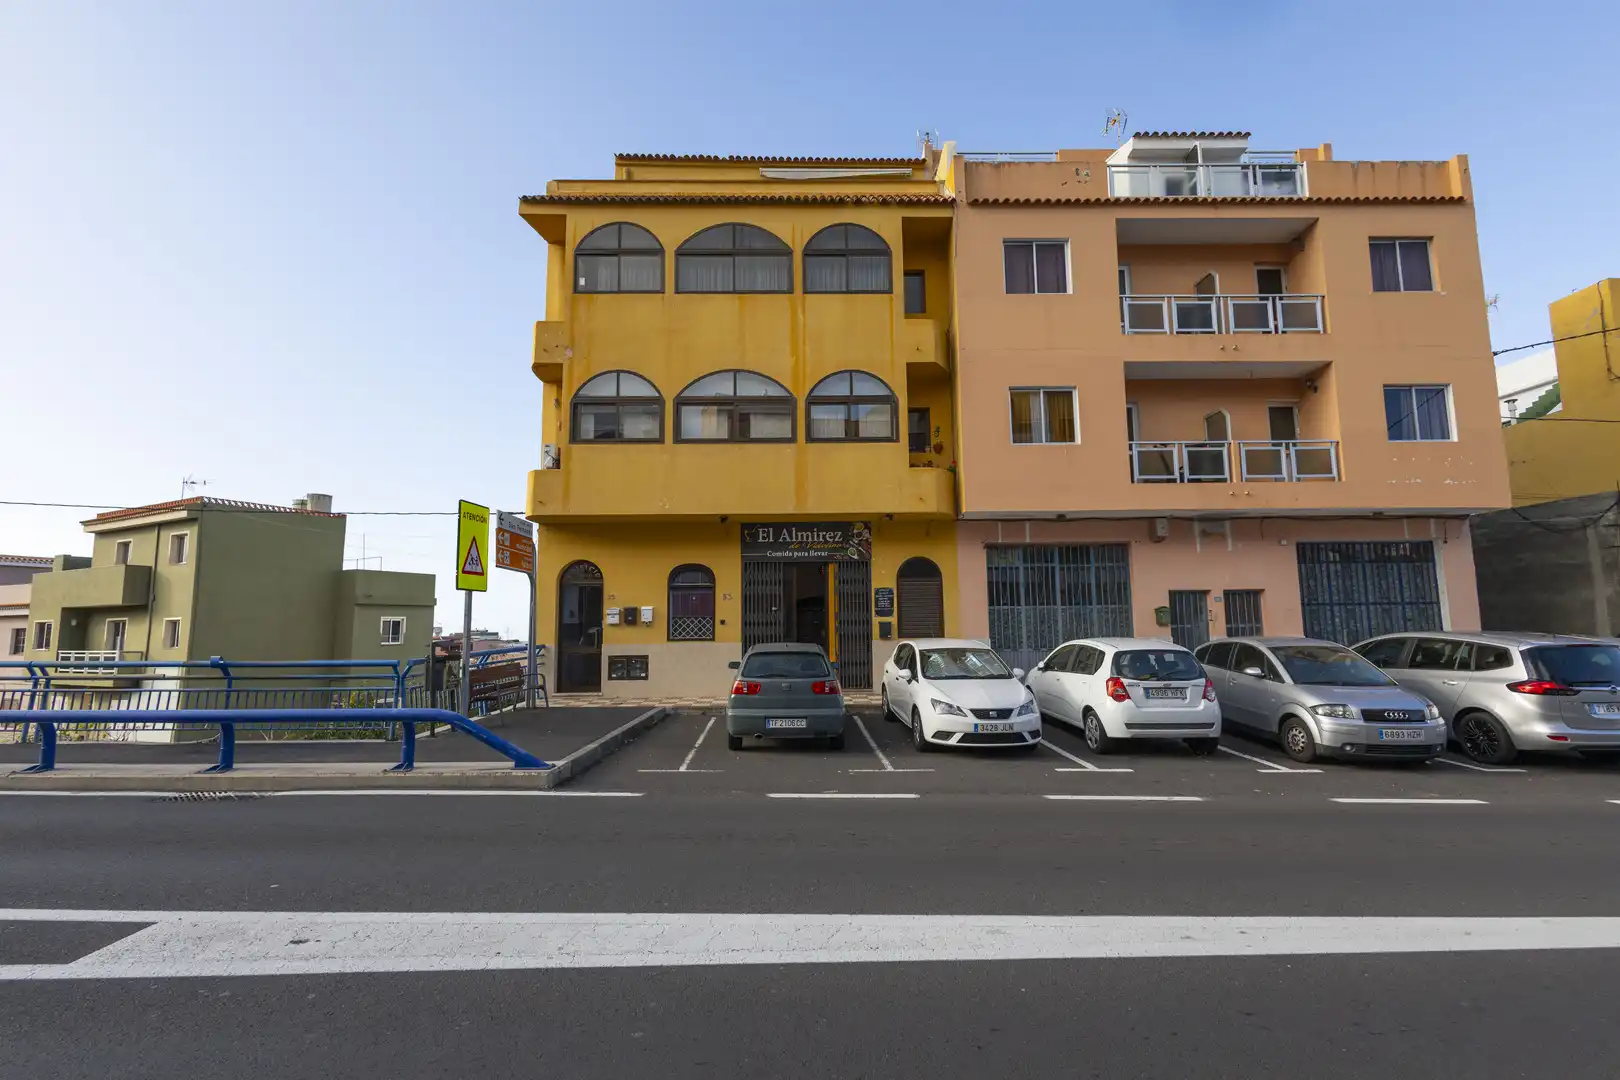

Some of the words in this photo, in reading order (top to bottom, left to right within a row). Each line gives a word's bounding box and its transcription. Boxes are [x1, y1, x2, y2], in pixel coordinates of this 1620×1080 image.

[462, 511, 488, 525] ATENCIÓN
[757, 527, 774, 542] El
[778, 527, 843, 542] Almirez
[980, 724, 998, 732] 3428
[1000, 724, 1014, 732] JLN
[1384, 731, 1405, 739] 6893
[1406, 731, 1422, 739] HZH
